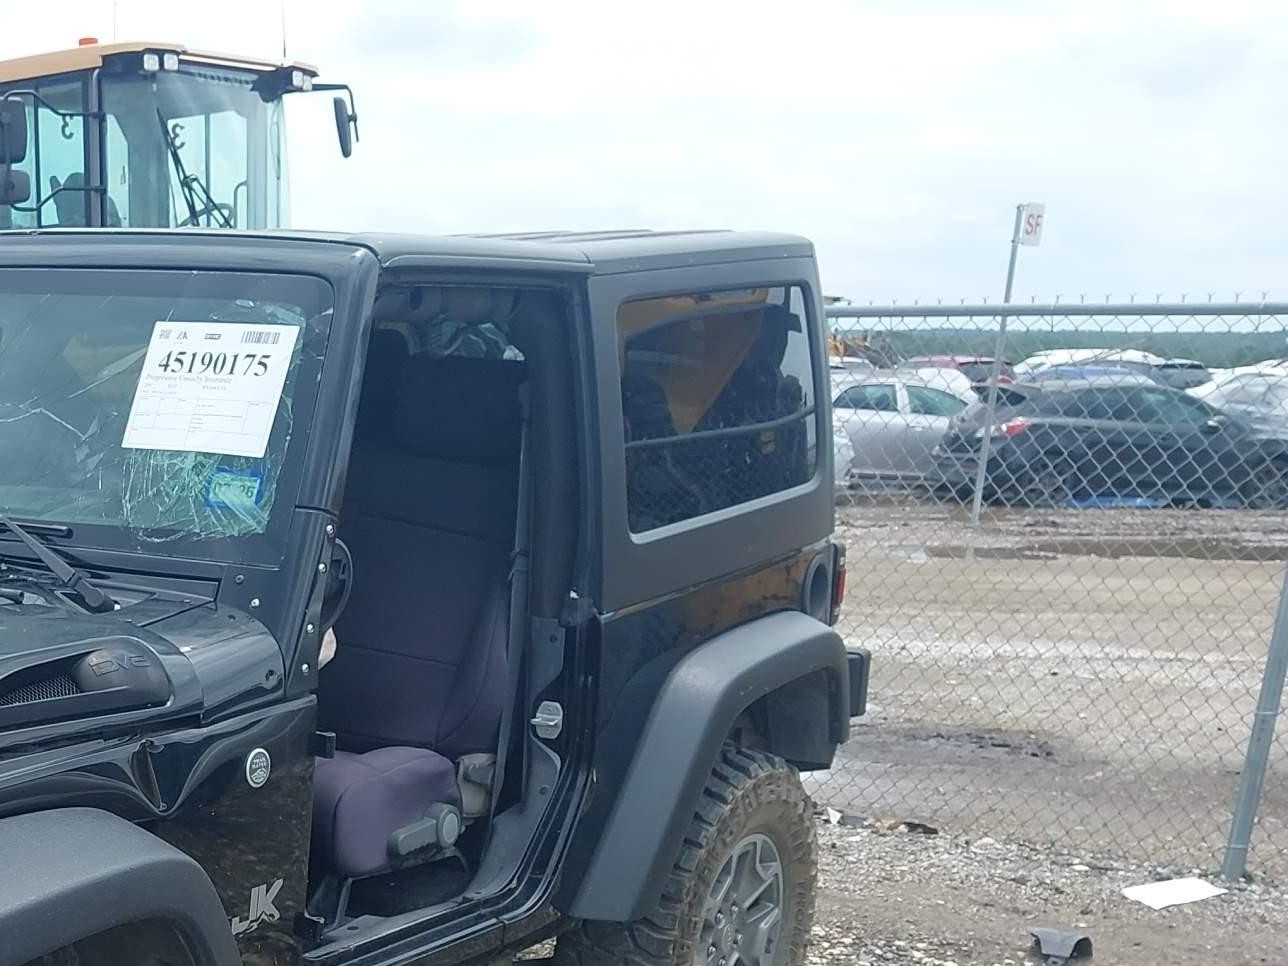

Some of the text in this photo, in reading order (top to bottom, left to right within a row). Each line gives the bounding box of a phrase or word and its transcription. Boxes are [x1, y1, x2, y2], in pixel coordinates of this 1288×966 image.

[1025, 213, 1043, 236] SF
[158, 350, 273, 377] 45190175
[232, 877, 284, 936] JK
